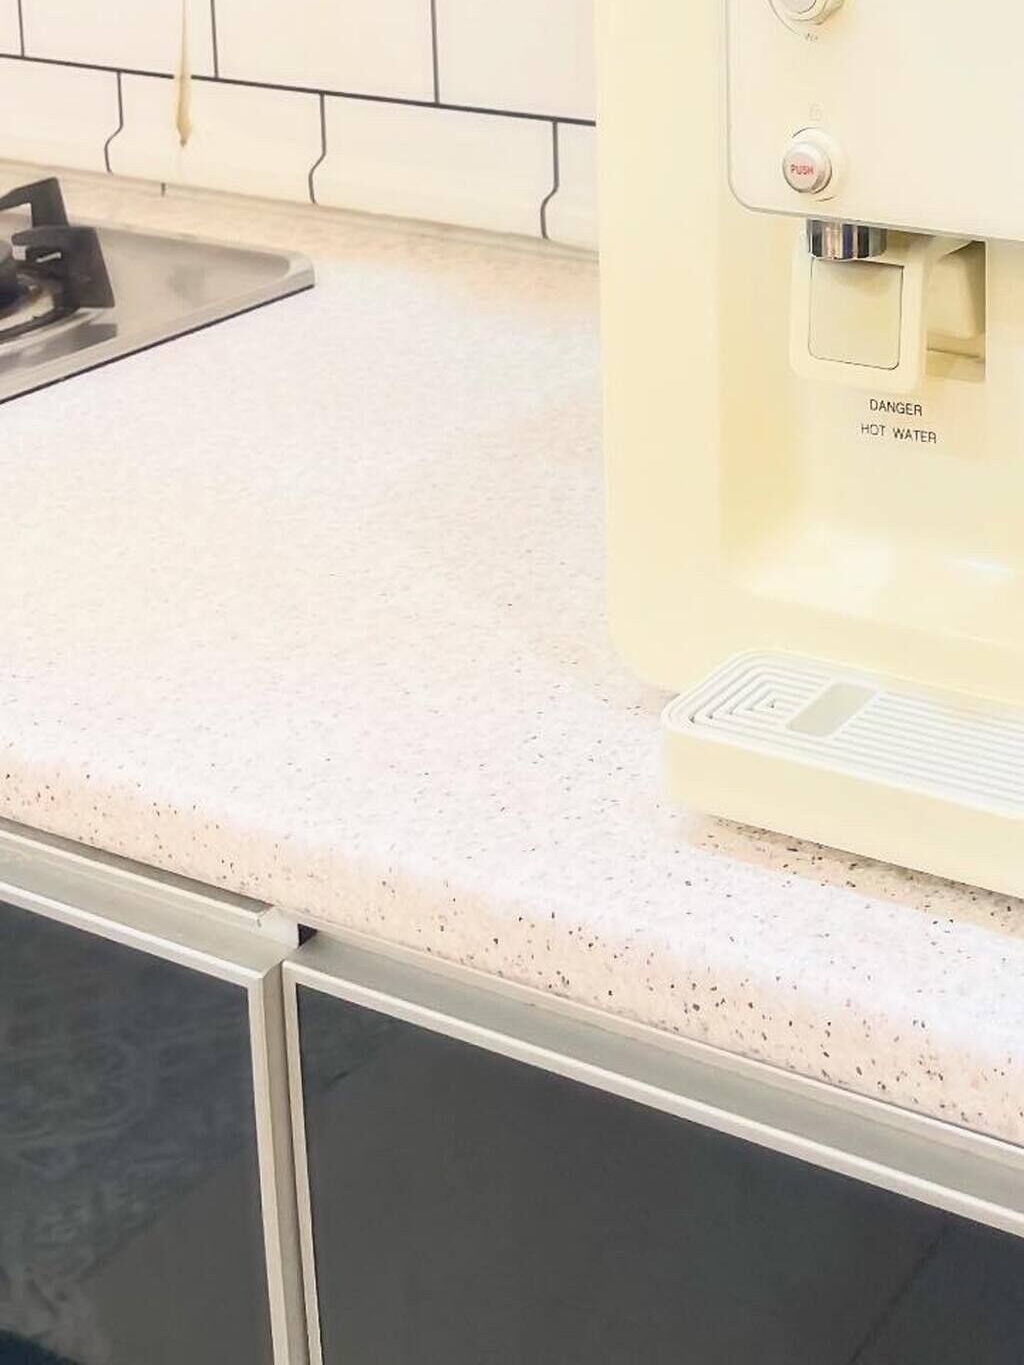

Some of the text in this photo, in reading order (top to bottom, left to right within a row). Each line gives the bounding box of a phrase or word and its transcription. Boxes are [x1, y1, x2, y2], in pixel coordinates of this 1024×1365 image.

[791, 164, 814, 175] PUSH
[869, 398, 922, 416] DANGER
[861, 424, 937, 444] HOT WATER
